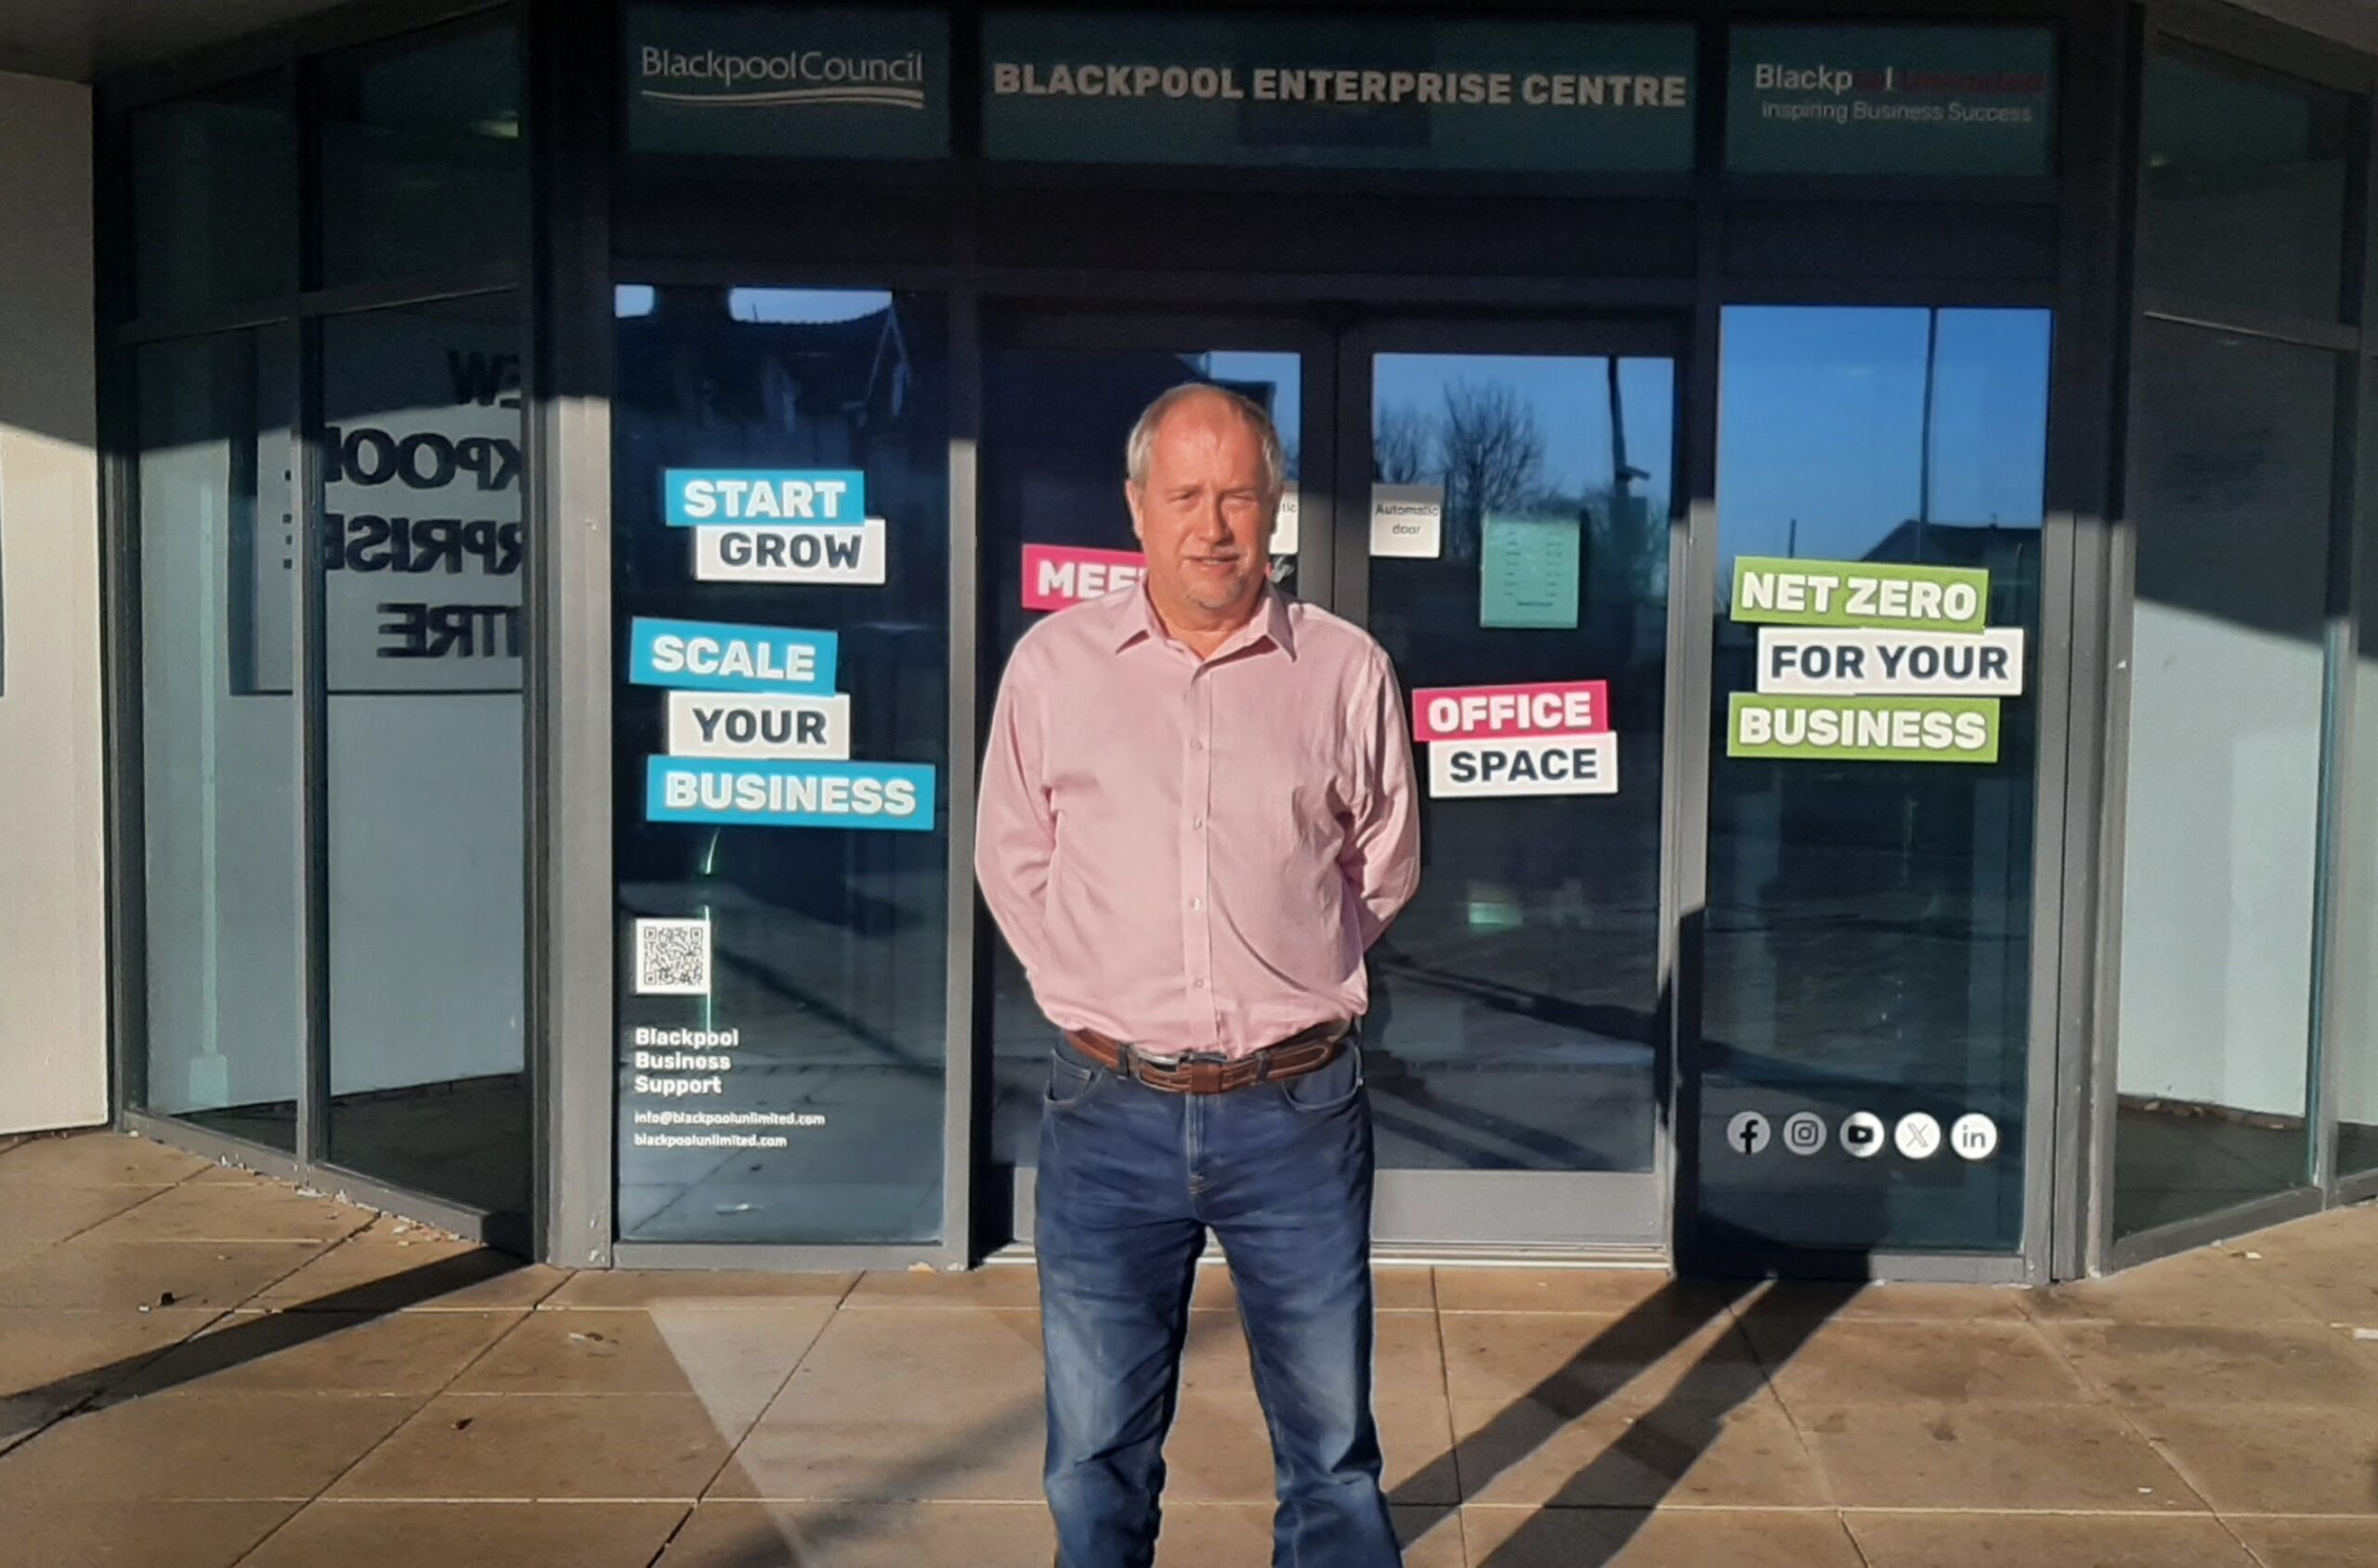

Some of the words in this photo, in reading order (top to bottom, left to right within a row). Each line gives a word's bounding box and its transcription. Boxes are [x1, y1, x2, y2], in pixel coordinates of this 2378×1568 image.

[993, 62, 1245, 98] BLACKPOOL
[1253, 68, 1512, 105] ENTERPRISE
[1522, 73, 1686, 107] CENTRE
[1762, 101, 1849, 124] Inspiring
[1853, 101, 1943, 122] Business
[1948, 102, 2033, 123] Success
[684, 480, 846, 518] START
[1376, 503, 1438, 516] Automatic
[1392, 524, 1422, 536] door
[719, 531, 863, 569] GROW
[1741, 571, 1839, 613] NET
[1845, 577, 1978, 621] ZERO
[652, 634, 817, 683] SCALE
[1770, 646, 1865, 679] FOR
[1875, 646, 2008, 680] YOUR
[693, 708, 828, 745] YOUR
[1428, 692, 1592, 733] OFFICE
[1739, 707, 1986, 750] BUSINESS
[1449, 748, 1598, 783] SPACE
[664, 772, 917, 816] BUSINESS
[634, 1027, 739, 1049] Blackpool
[634, 1052, 731, 1070] Business
[634, 1076, 722, 1096] Support
[634, 1110, 826, 1126] info@blackpoolunlimited.com
[634, 1133, 787, 1147] blackpoolunlimited.com
